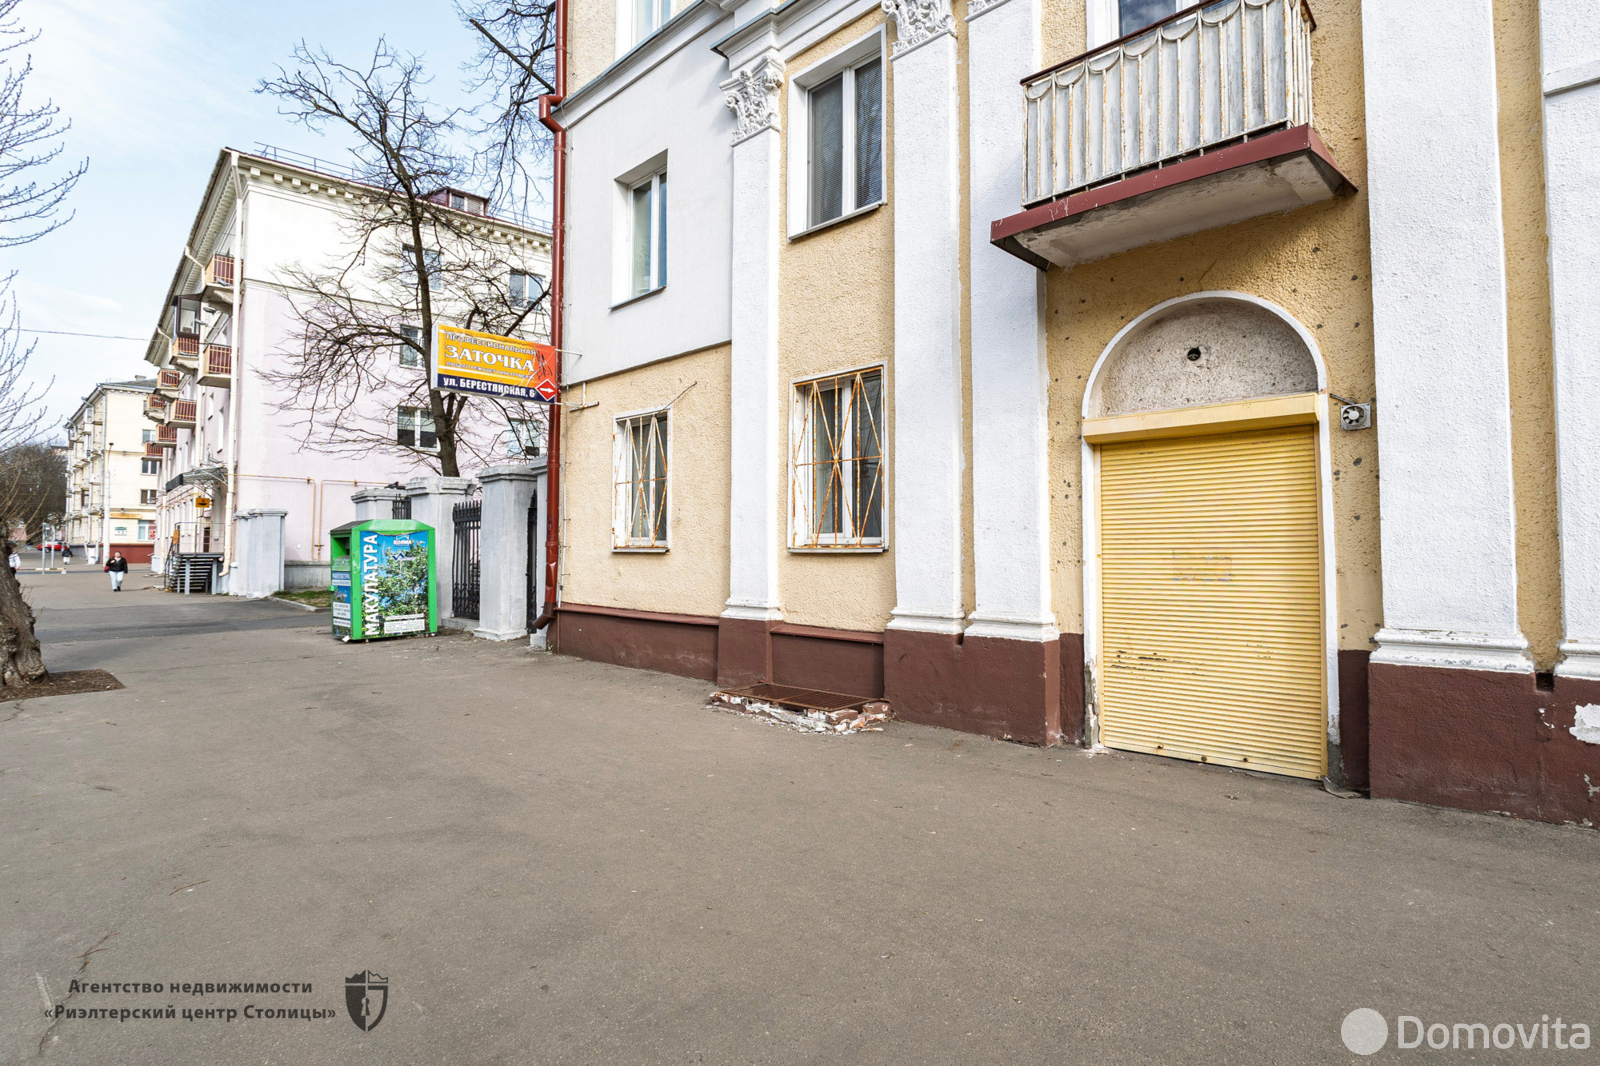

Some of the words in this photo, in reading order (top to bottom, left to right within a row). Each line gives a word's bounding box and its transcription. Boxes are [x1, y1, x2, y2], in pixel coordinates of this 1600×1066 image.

[446, 334, 536, 355] ПРОФЕССИОНАЛЬНАЯ
[445, 345, 535, 372] ЗАТОЧКА
[459, 378, 528, 398] БЕРЕСТЯНСКАЯ,
[529, 390, 535, 398] 6
[363, 534, 380, 635] МАКУЛАТУРА
